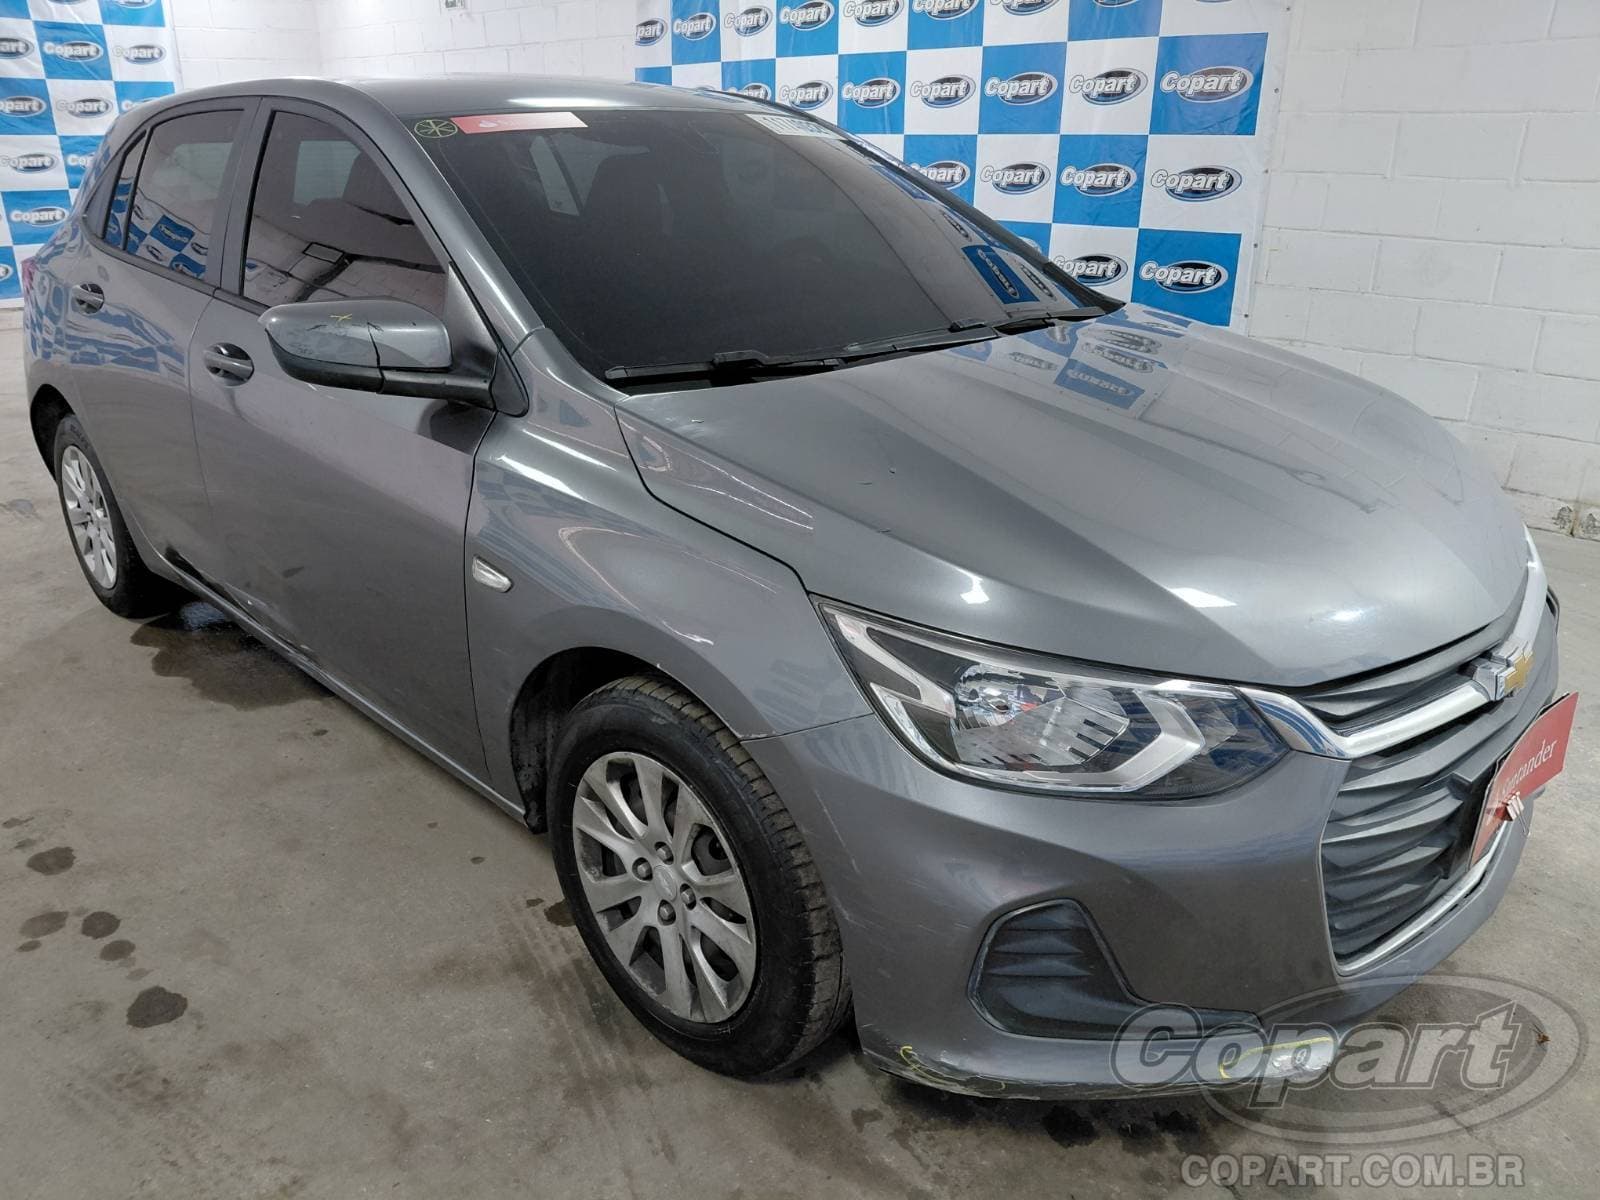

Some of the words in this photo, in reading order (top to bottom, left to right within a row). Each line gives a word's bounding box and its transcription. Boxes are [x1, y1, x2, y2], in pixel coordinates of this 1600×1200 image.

[724, 8, 766, 31] Copart
[781, 4, 828, 26] Copart
[845, 0, 897, 20] Copart
[673, 17, 711, 36] Copart
[43, 42, 97, 58] Copart
[113, 45, 160, 60] Copart
[779, 84, 828, 104] Copart
[843, 81, 896, 103] Copart
[910, 79, 967, 102] Copart
[985, 76, 1050, 100] Copart
[1070, 73, 1137, 98] Copart
[1160, 71, 1243, 96] Copart
[57, 100, 107, 115] Copart
[0, 154, 51, 169] Copart
[980, 165, 1040, 187] Copart
[1061, 166, 1128, 190] Copart
[1152, 169, 1231, 193] Copart
[11, 209, 63, 224] Copart
[1140, 261, 1217, 287] Copart
